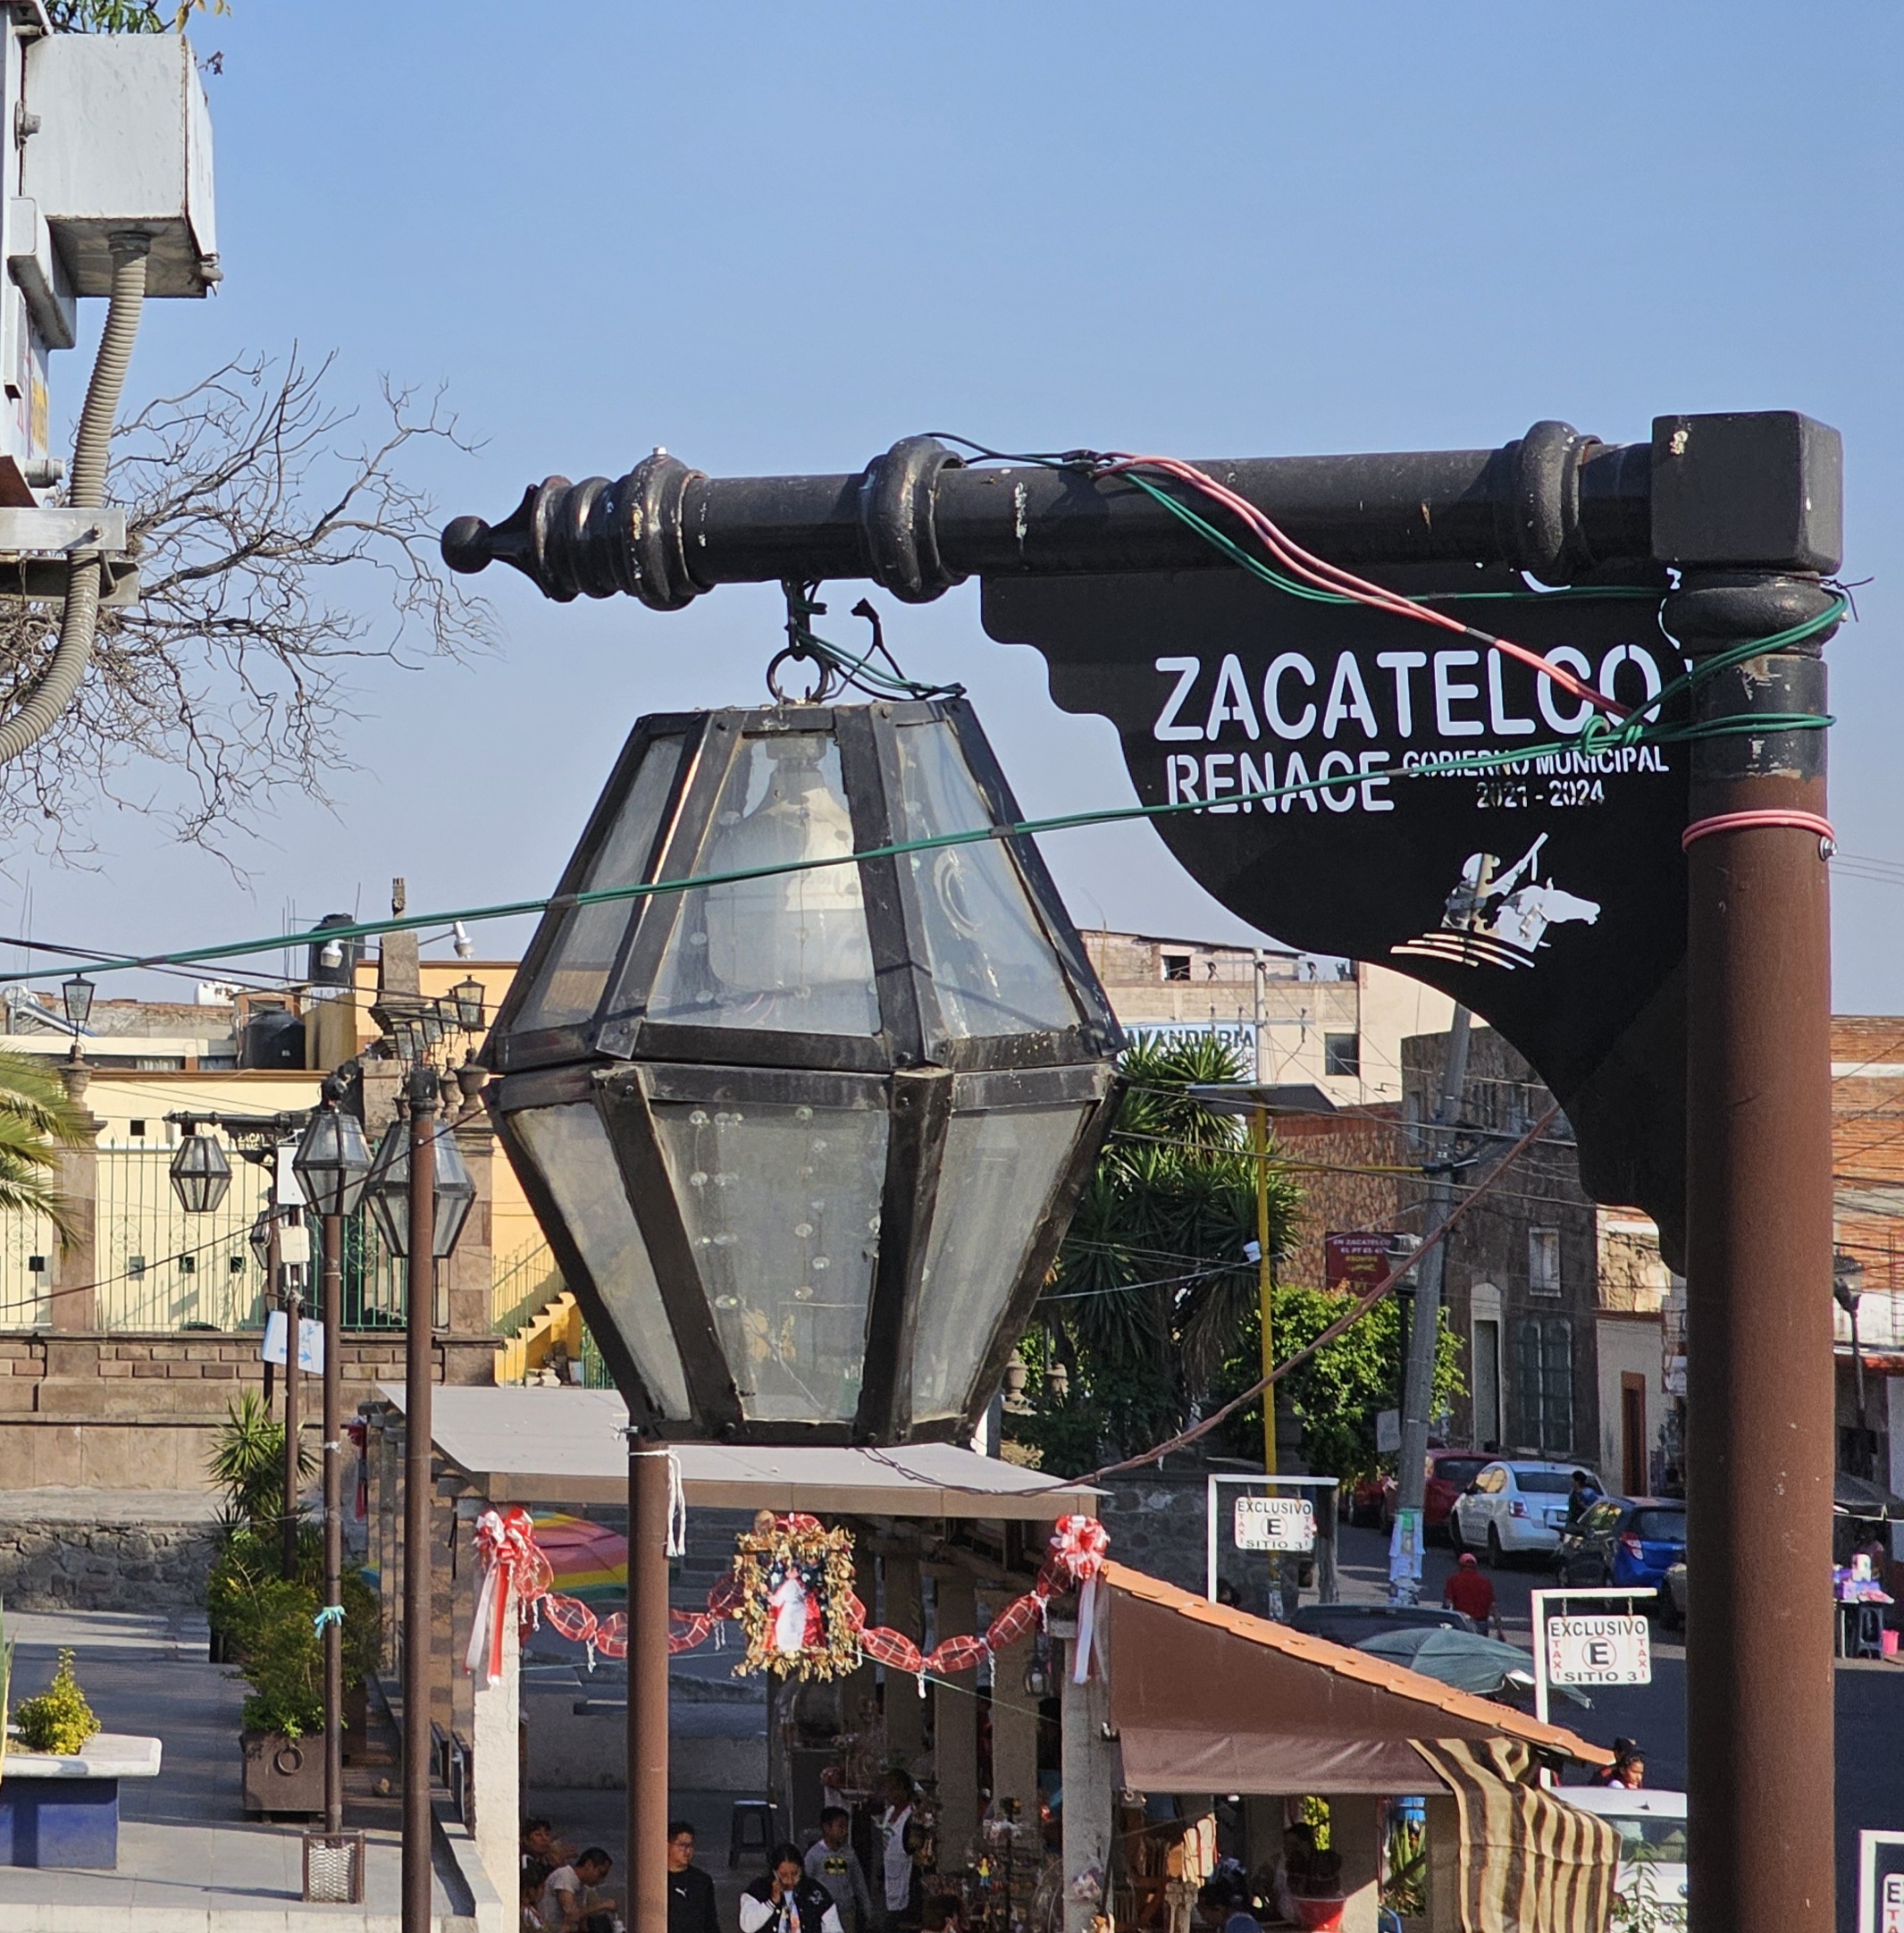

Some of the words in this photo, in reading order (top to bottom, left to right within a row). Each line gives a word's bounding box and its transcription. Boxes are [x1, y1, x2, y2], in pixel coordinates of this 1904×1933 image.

[1153, 644, 1662, 742] ZACATELCO
[1402, 749, 1530, 778] GOBIERNO
[1535, 745, 1670, 776] MUNICIPAL
[1166, 750, 1395, 814] RENACE
[1475, 781, 1528, 809] 2021
[1548, 778, 1606, 807] 2024
[1237, 1500, 1312, 1516] EXCLUSIVO
[1266, 1518, 1282, 1536] E
[1246, 1539, 1288, 1550] SITIO
[1294, 1542, 1304, 1551] 3
[1550, 1620, 1646, 1637] EXCLUSIVO
[1552, 1640, 1562, 1680] TAXI
[1589, 1642, 1610, 1666] E
[1637, 1638, 1648, 1678] TAXI
[1564, 1671, 1619, 1682] SITIO
[1627, 1670, 1638, 1682] 3
[1887, 1881, 1904, 1904] E
